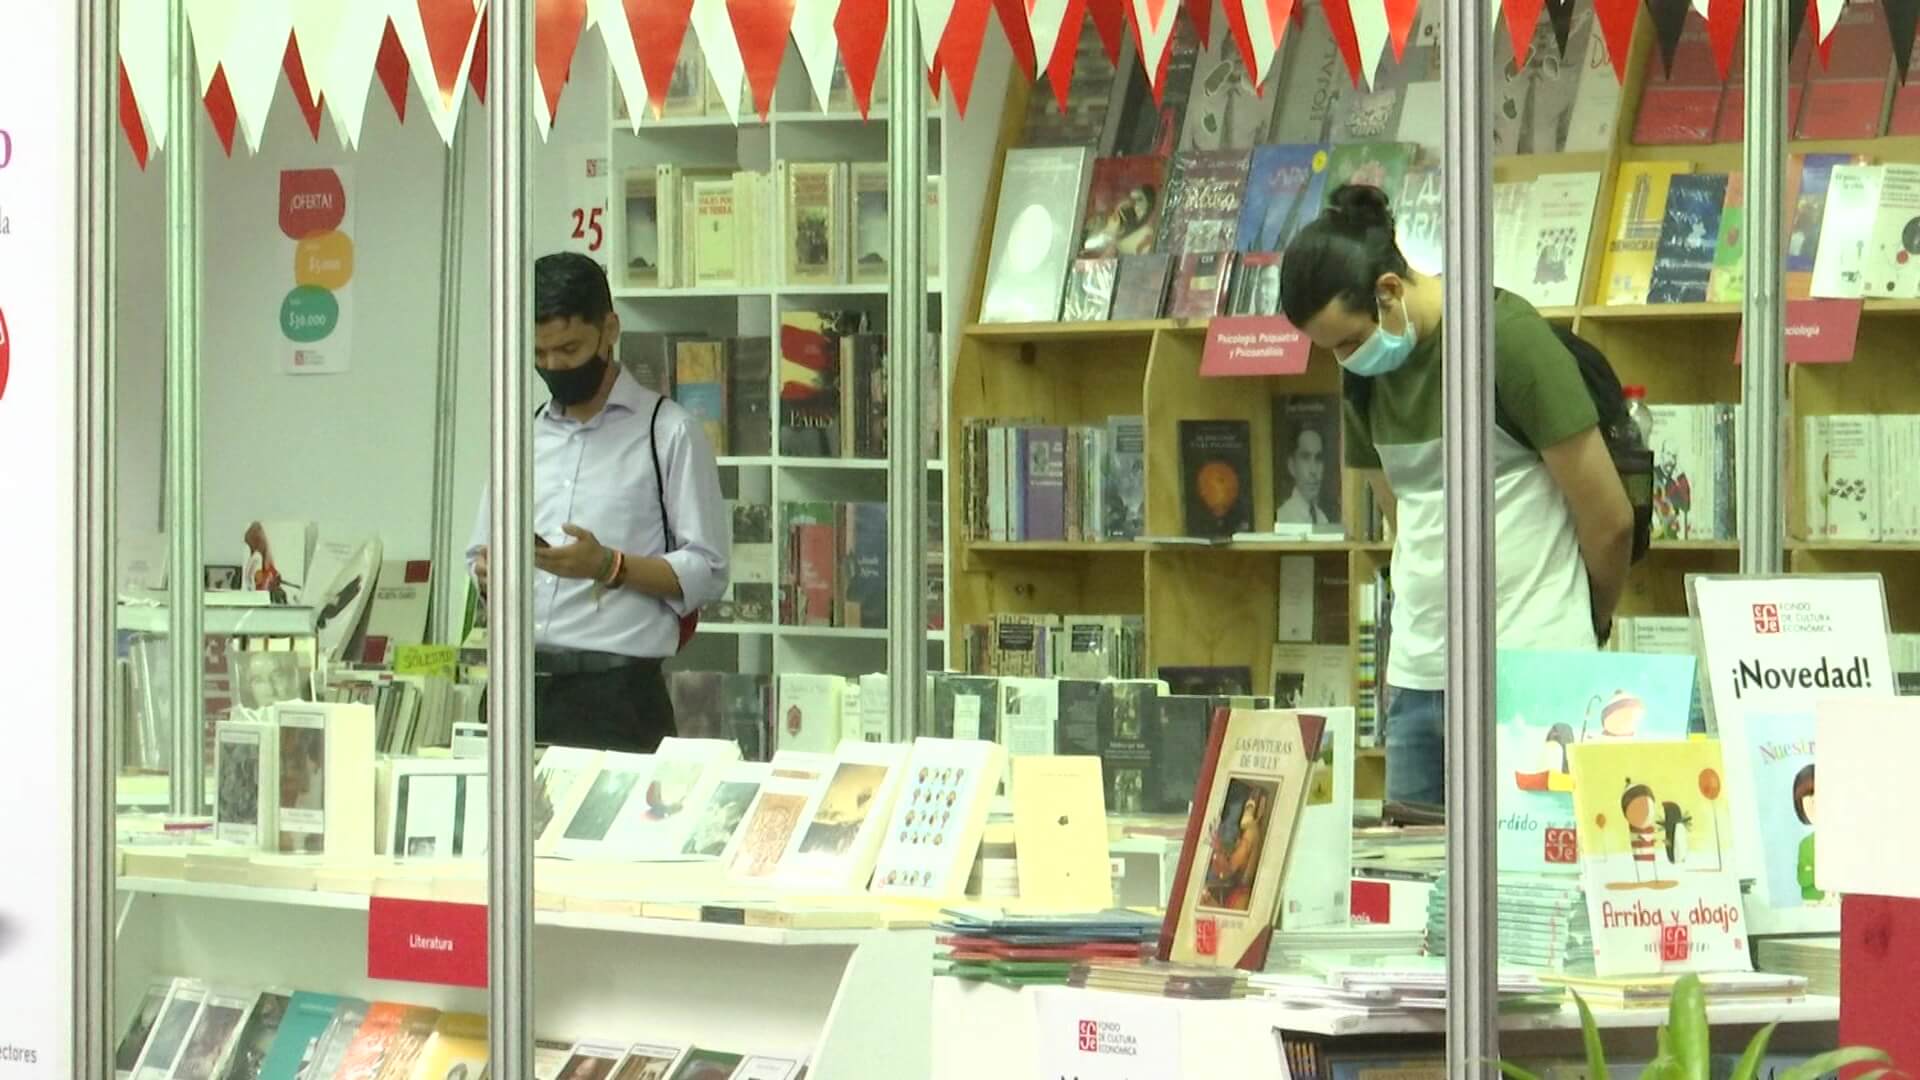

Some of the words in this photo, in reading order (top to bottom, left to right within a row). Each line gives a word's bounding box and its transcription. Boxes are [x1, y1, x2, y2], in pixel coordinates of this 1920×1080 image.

[290, 193, 332, 213] ¡OFERTA!
[1779, 602, 1811, 612] FONDO
[1795, 613, 1831, 623] CULTURA
[1732, 656, 1872, 699] ¡Novedad!
[1235, 735, 1252, 752] LAS
[1253, 737, 1293, 754] PINTURAS
[1239, 753, 1251, 768] DE
[1602, 899, 1663, 928] Arriba
[1670, 909, 1680, 926] y
[1689, 897, 1739, 933] abajo
[409, 933, 454, 952] Literatura
[1106, 1032, 1137, 1045] CULTURA
